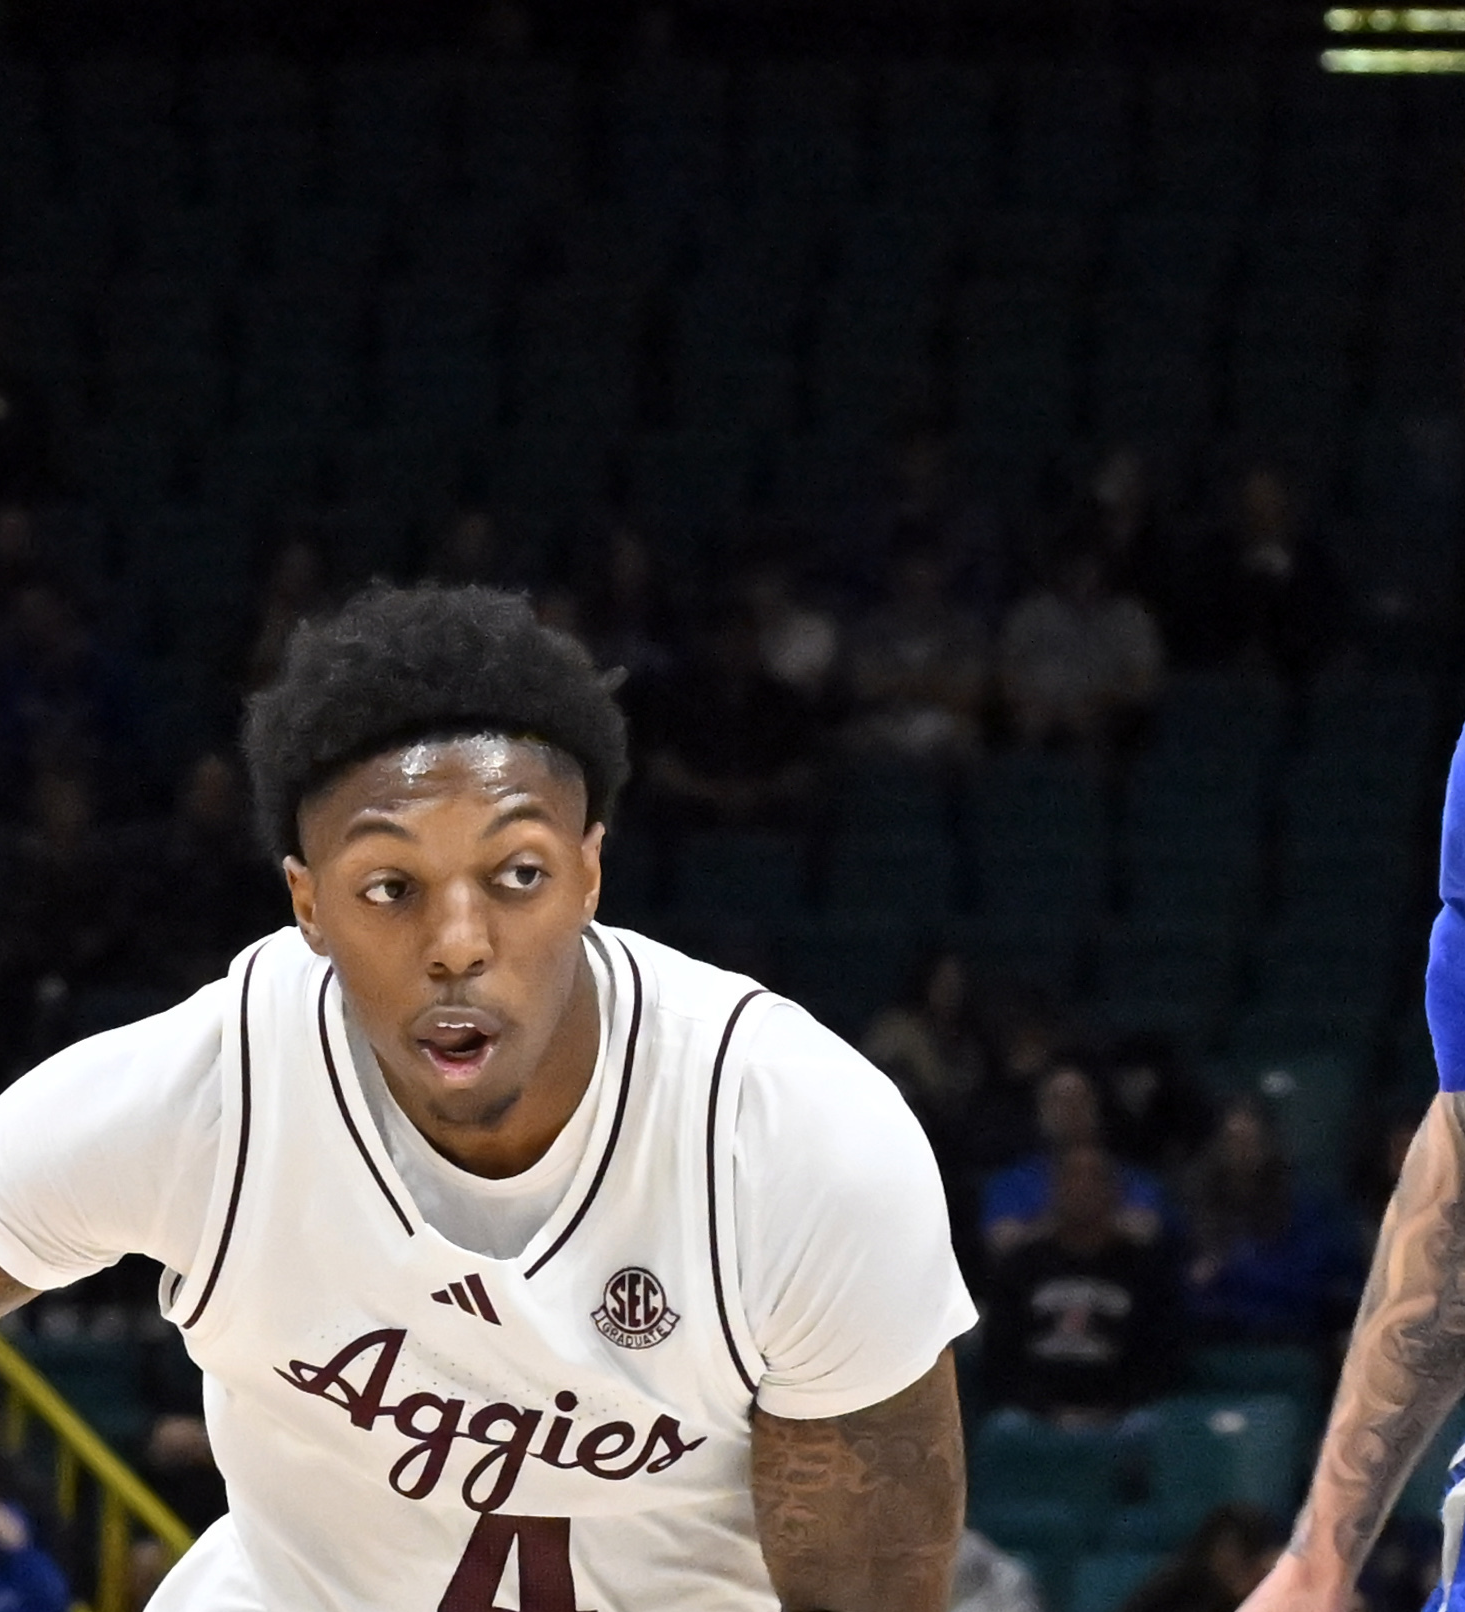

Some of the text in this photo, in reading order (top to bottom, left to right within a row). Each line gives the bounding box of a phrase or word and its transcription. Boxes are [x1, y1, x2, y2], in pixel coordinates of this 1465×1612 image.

[609, 1273, 659, 1328] SEC
[601, 1321, 667, 1348] GRADUATE
[273, 1328, 708, 1513] Aggies
